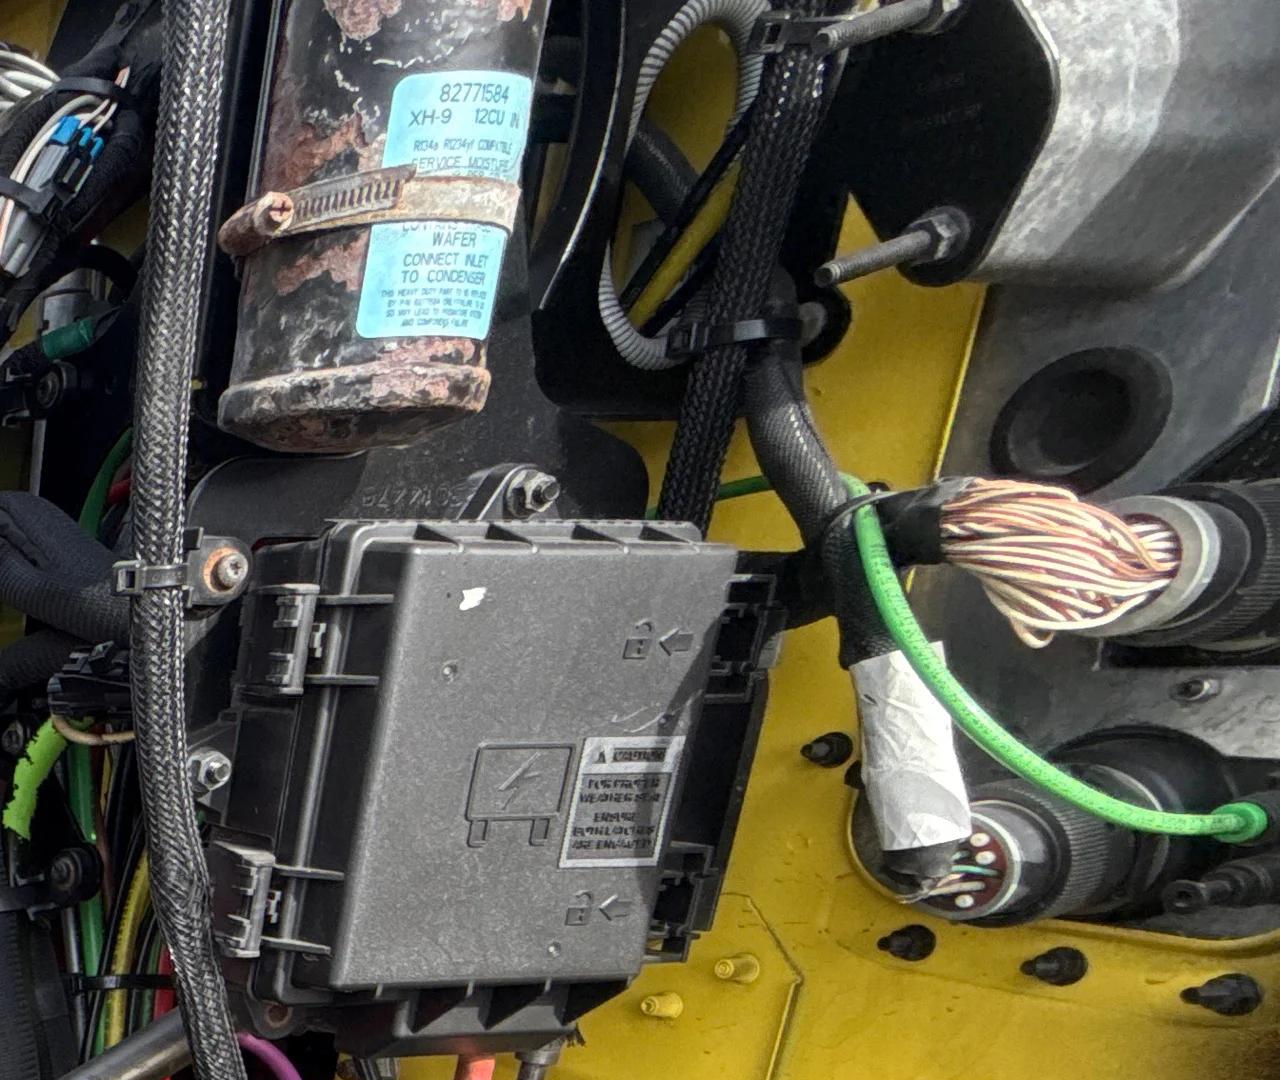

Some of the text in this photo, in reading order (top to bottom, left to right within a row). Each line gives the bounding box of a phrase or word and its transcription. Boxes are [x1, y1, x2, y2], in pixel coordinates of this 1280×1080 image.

[439, 83, 510, 104] 82771584
[408, 108, 452, 128] XH-9
[475, 108, 506, 126] 12CU
[432, 231, 477, 248] WAFER
[403, 253, 489, 268] CONNECT INLET
[401, 270, 486, 285] TO CONDENSER
